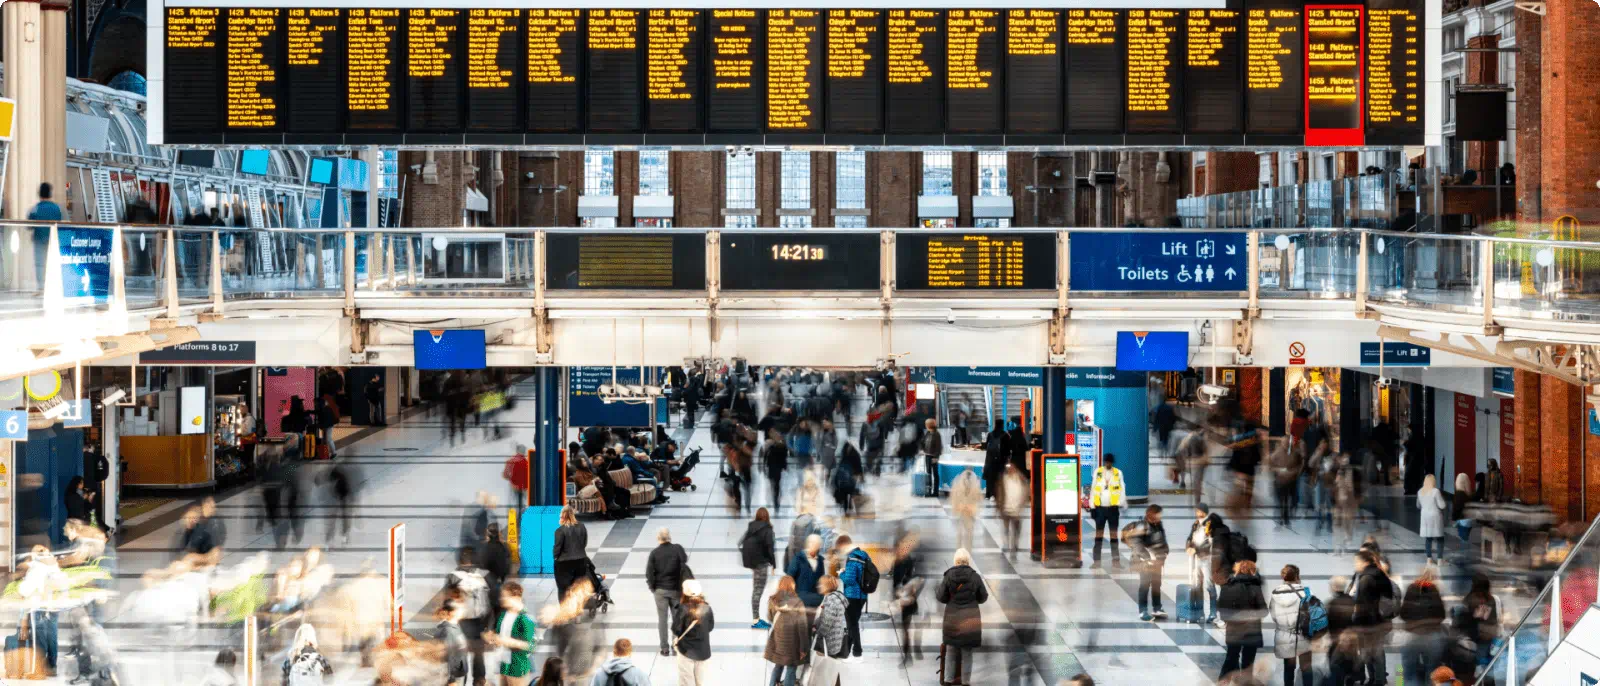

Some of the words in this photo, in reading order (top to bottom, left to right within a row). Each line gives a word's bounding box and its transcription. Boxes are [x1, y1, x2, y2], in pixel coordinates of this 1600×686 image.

[772, 244, 809, 260] 14:21
[1162, 242, 1188, 255] Lift
[1118, 266, 1168, 280] Toilets
[6, 416, 19, 434] 6
